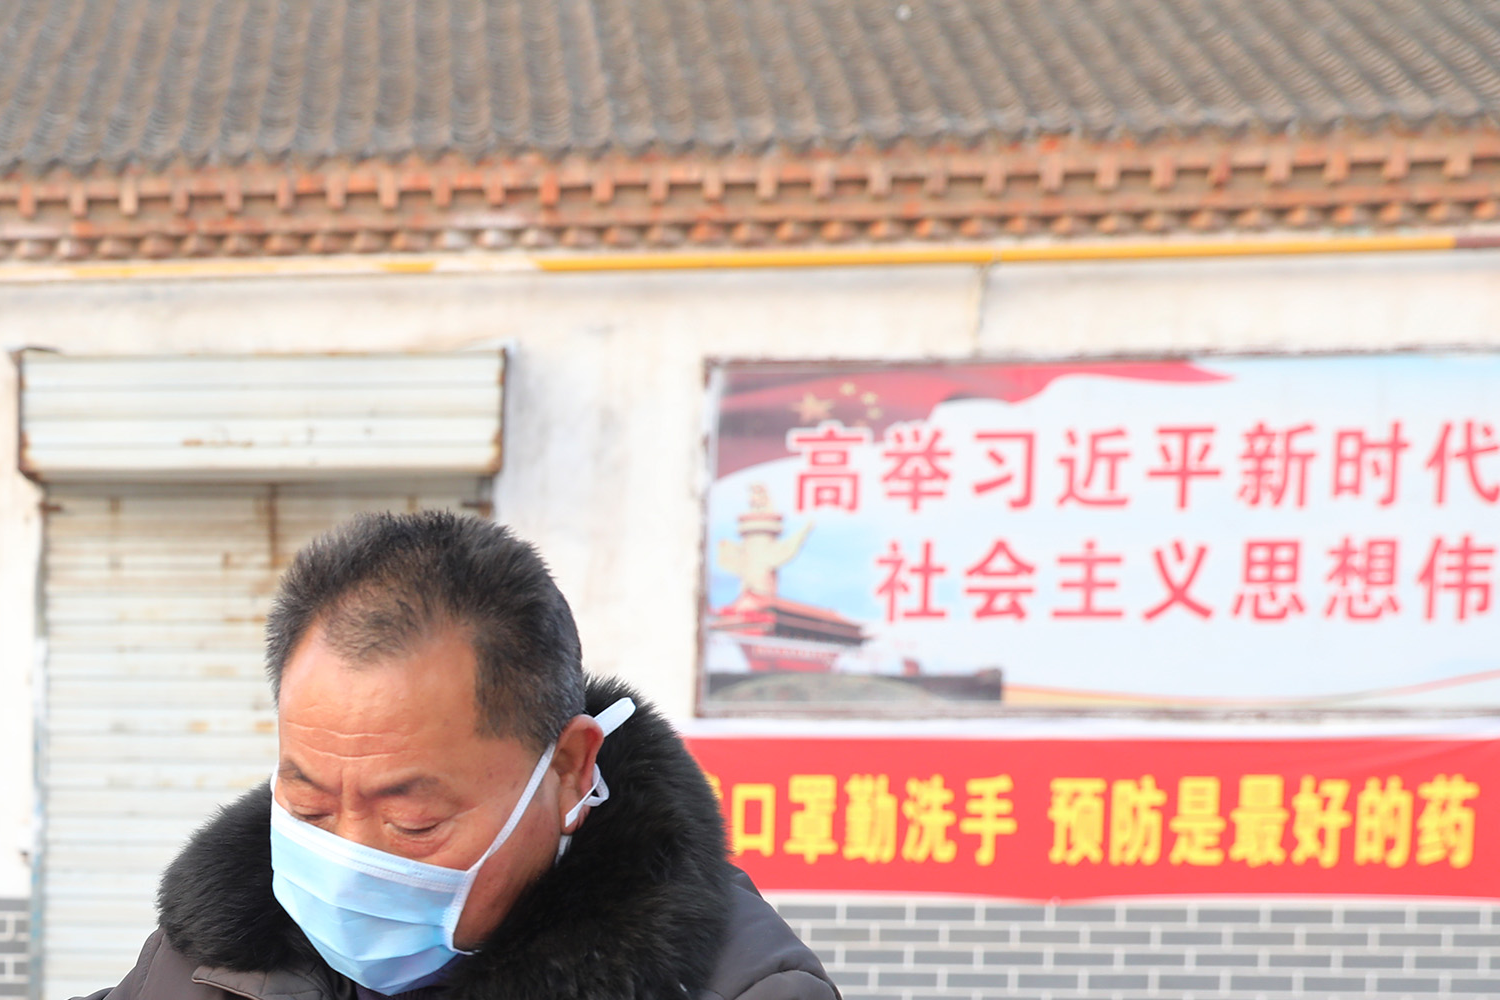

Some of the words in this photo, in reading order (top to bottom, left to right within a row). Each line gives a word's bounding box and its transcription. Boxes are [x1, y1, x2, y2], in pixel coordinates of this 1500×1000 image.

[794, 421, 1500, 512] 高举习近平新时代
[875, 535, 1497, 622] 社会主义思想伟
[704, 773, 1017, 866] 口罩勤洗手
[1047, 773, 1480, 868] 预防是最好的药
